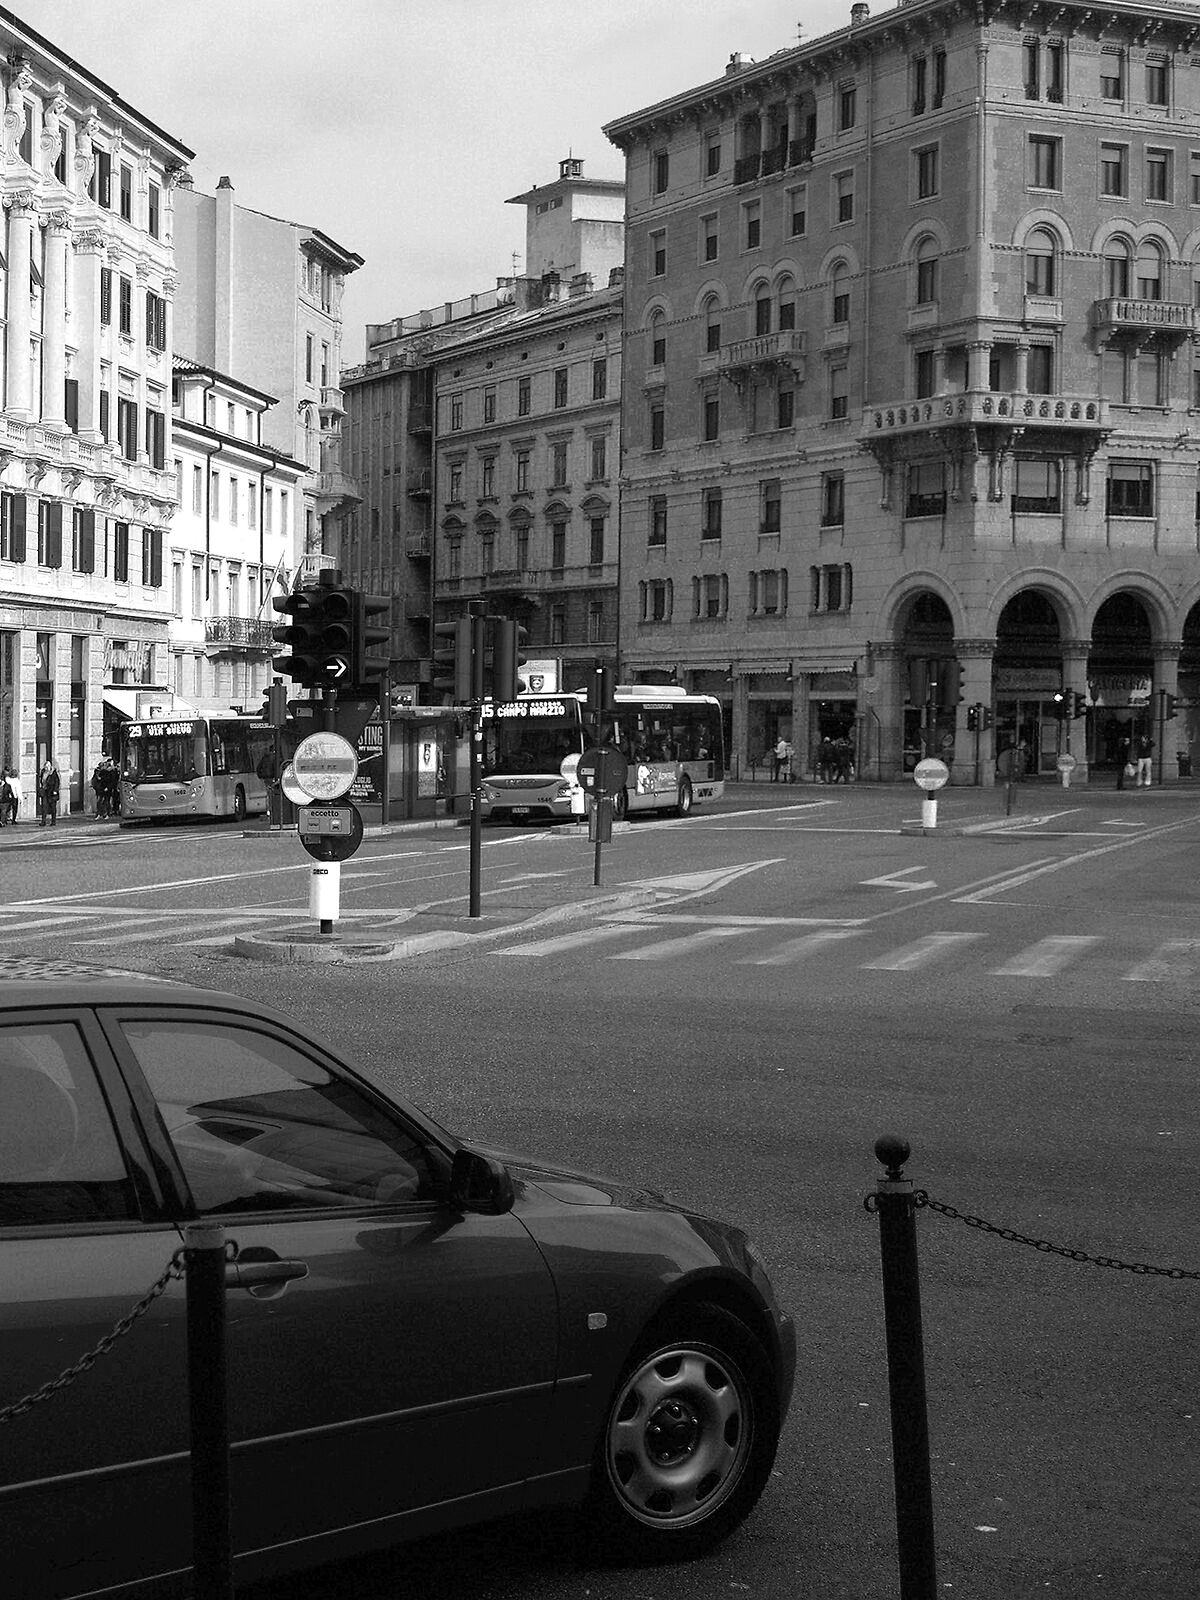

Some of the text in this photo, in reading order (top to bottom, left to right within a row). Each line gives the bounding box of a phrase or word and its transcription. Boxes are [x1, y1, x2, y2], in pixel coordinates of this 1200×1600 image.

[481, 704, 494, 718] 15
[497, 705, 565, 717] CAMPO MARZIO
[128, 725, 142, 738] 29
[310, 810, 339, 818] eccetto
